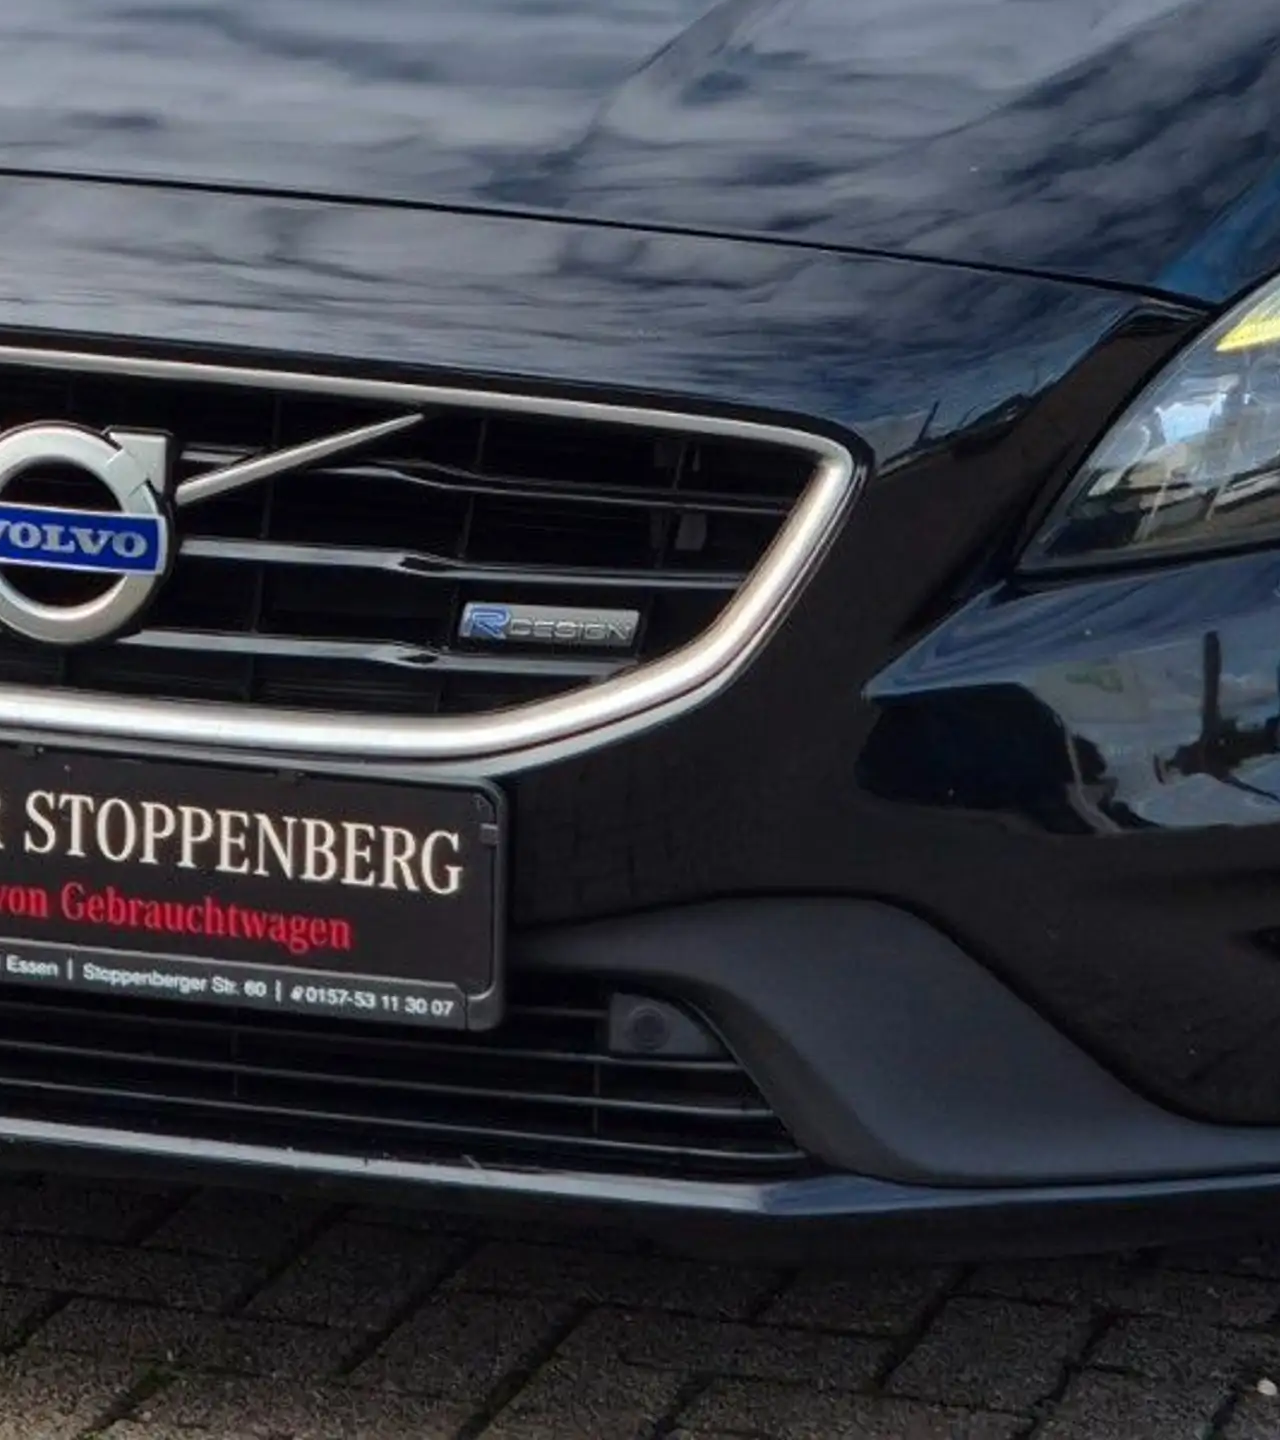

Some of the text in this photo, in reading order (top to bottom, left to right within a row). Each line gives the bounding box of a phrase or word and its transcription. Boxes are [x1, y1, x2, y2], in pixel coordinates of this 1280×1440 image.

[23, 789, 464, 895] STOPPENBERG
[61, 881, 353, 954] Gebrauchtwagen
[6, 954, 59, 977] Essen
[83, 962, 207, 994] Stoppenberger
[381, 995, 399, 1011] 11
[404, 995, 428, 1015] 30
[430, 1000, 455, 1017] 07
